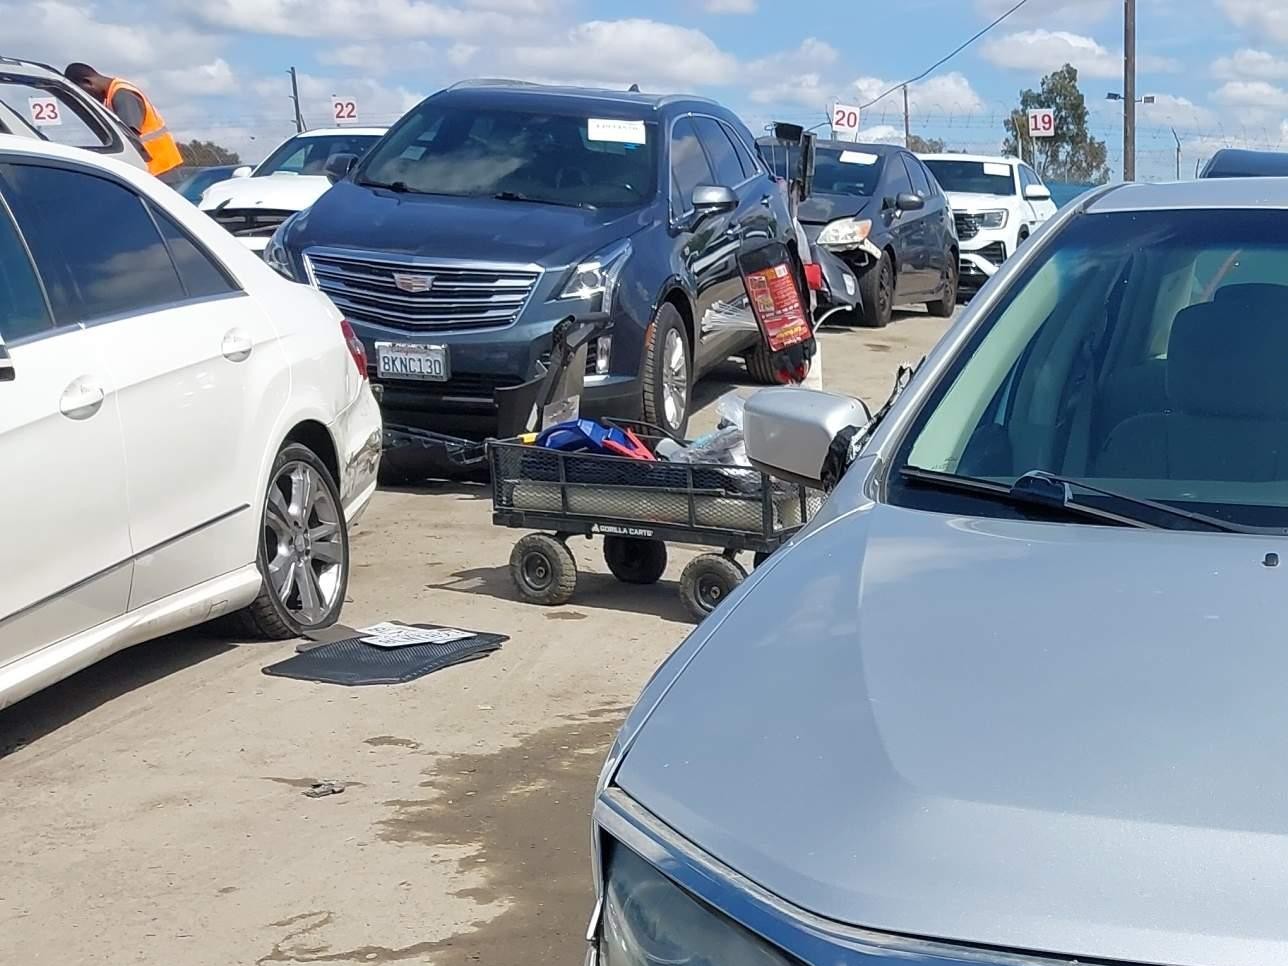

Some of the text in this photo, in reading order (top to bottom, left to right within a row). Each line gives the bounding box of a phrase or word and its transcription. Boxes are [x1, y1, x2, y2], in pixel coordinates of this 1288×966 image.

[32, 103, 58, 120] 23
[334, 102, 356, 118] 22
[834, 110, 857, 128] 20
[1030, 114, 1053, 131] 19
[382, 355, 442, 375] 8KNC130
[599, 524, 628, 535] GORILLA
